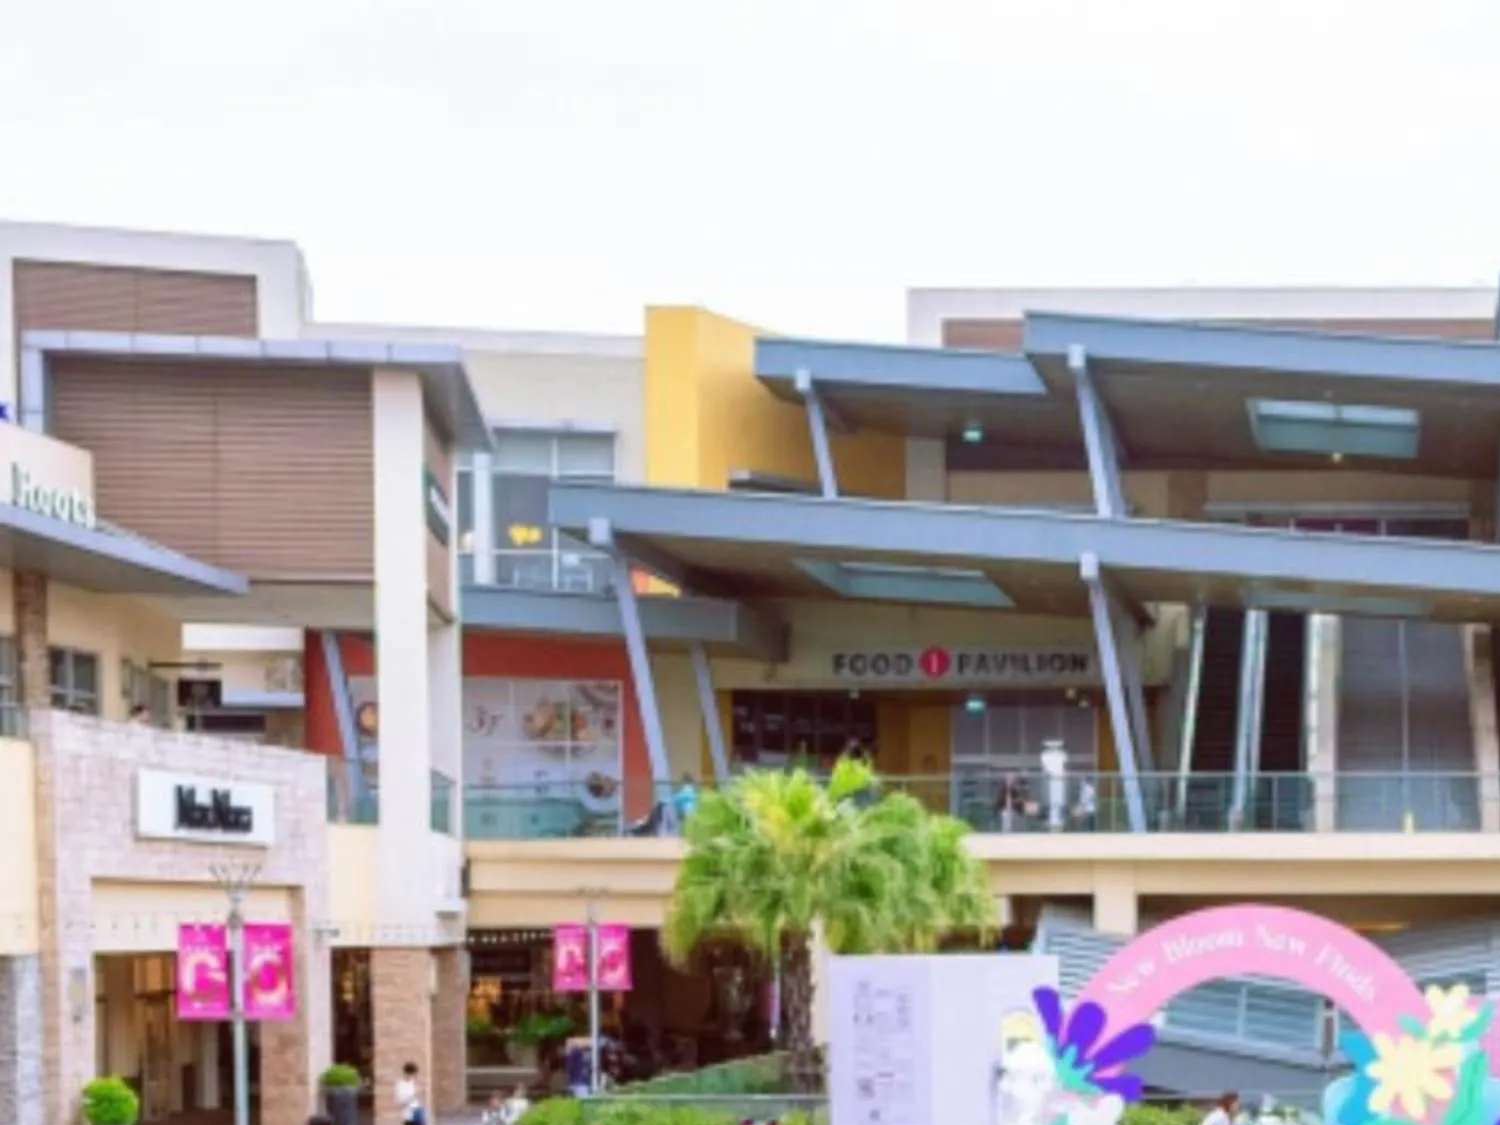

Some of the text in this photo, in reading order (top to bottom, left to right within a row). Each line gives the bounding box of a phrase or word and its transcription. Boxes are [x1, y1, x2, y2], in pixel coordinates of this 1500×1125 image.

[832, 652, 914, 676] FOOD
[957, 653, 1090, 676] PAVILION
[1162, 929, 1245, 963] Bloom
